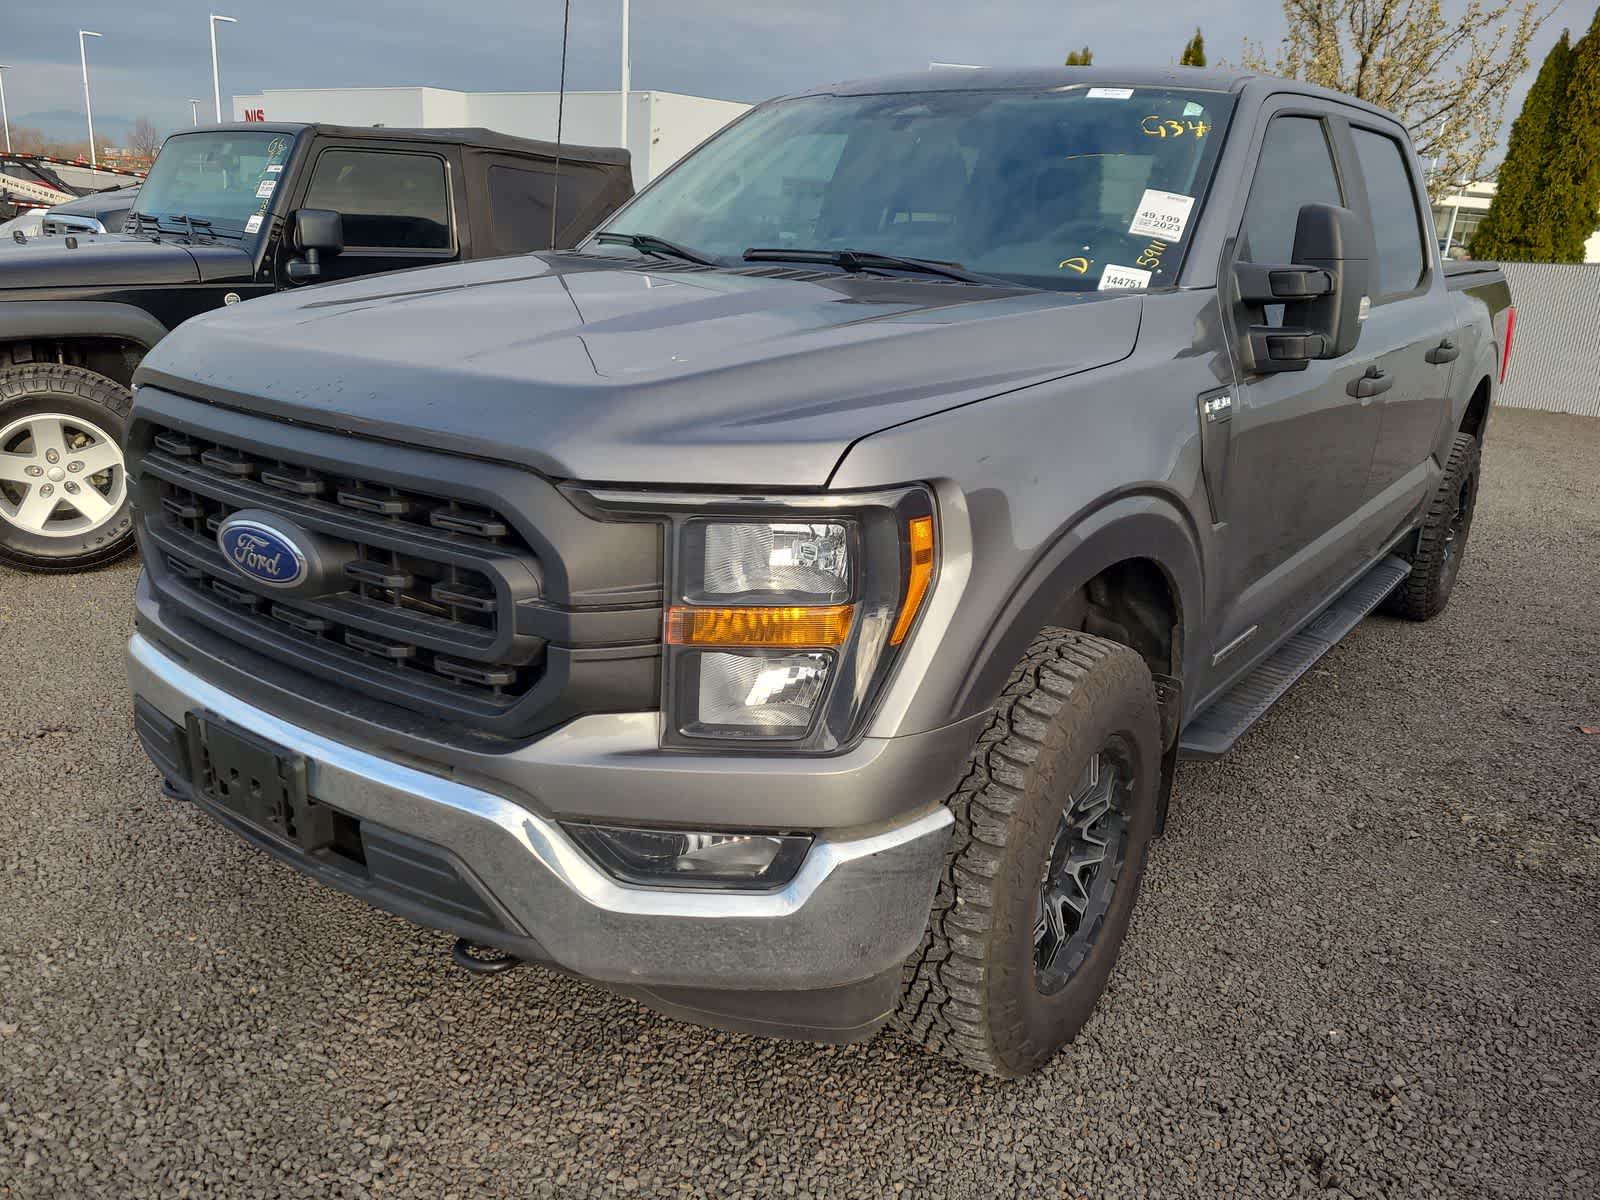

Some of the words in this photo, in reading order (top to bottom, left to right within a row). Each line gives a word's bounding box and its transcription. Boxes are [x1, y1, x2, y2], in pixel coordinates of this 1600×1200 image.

[1153, 220, 1181, 232] 2023
[1106, 275, 1142, 288] 144751
[234, 533, 281, 575] Ford
